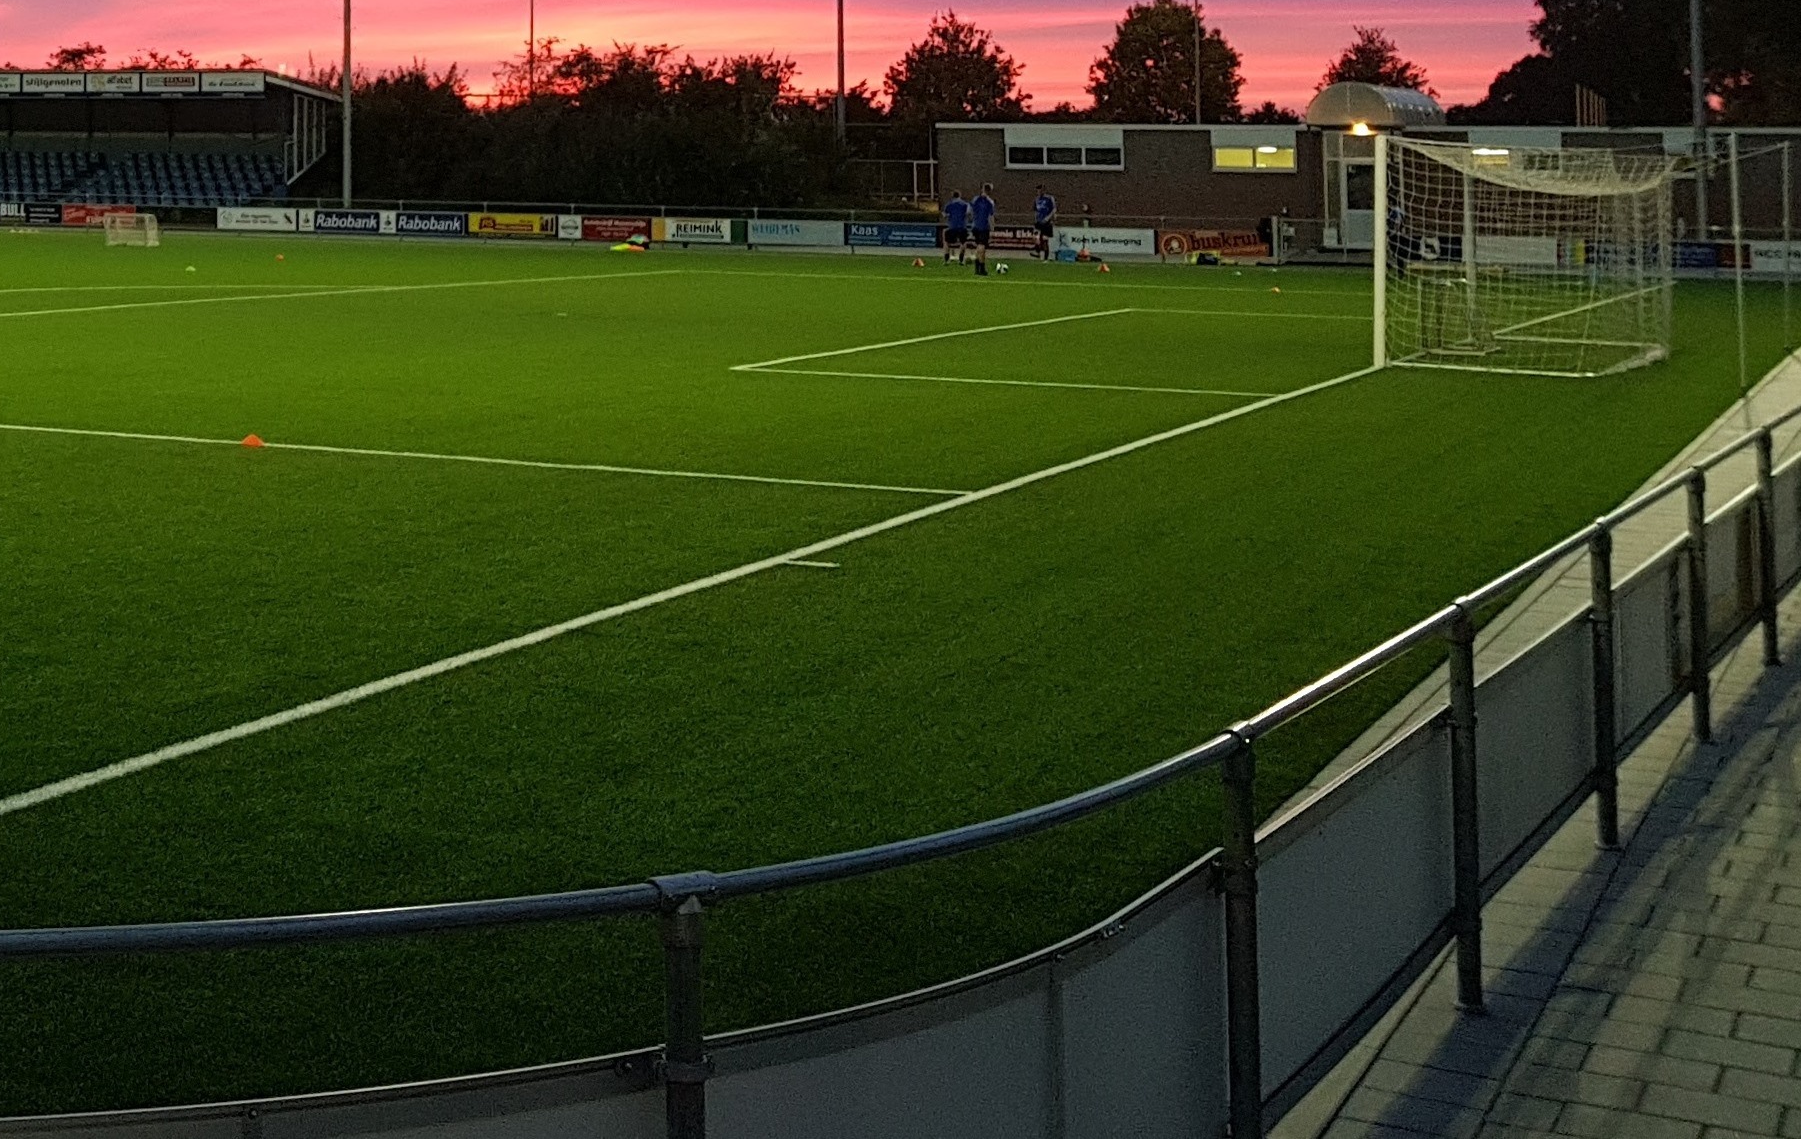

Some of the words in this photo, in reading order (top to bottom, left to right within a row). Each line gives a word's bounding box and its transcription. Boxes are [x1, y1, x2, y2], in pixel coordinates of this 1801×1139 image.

[0, 203, 26, 217] BULL
[316, 213, 378, 229] Rabobank
[398, 215, 462, 231] Rabobank
[850, 224, 879, 236] Kaas
